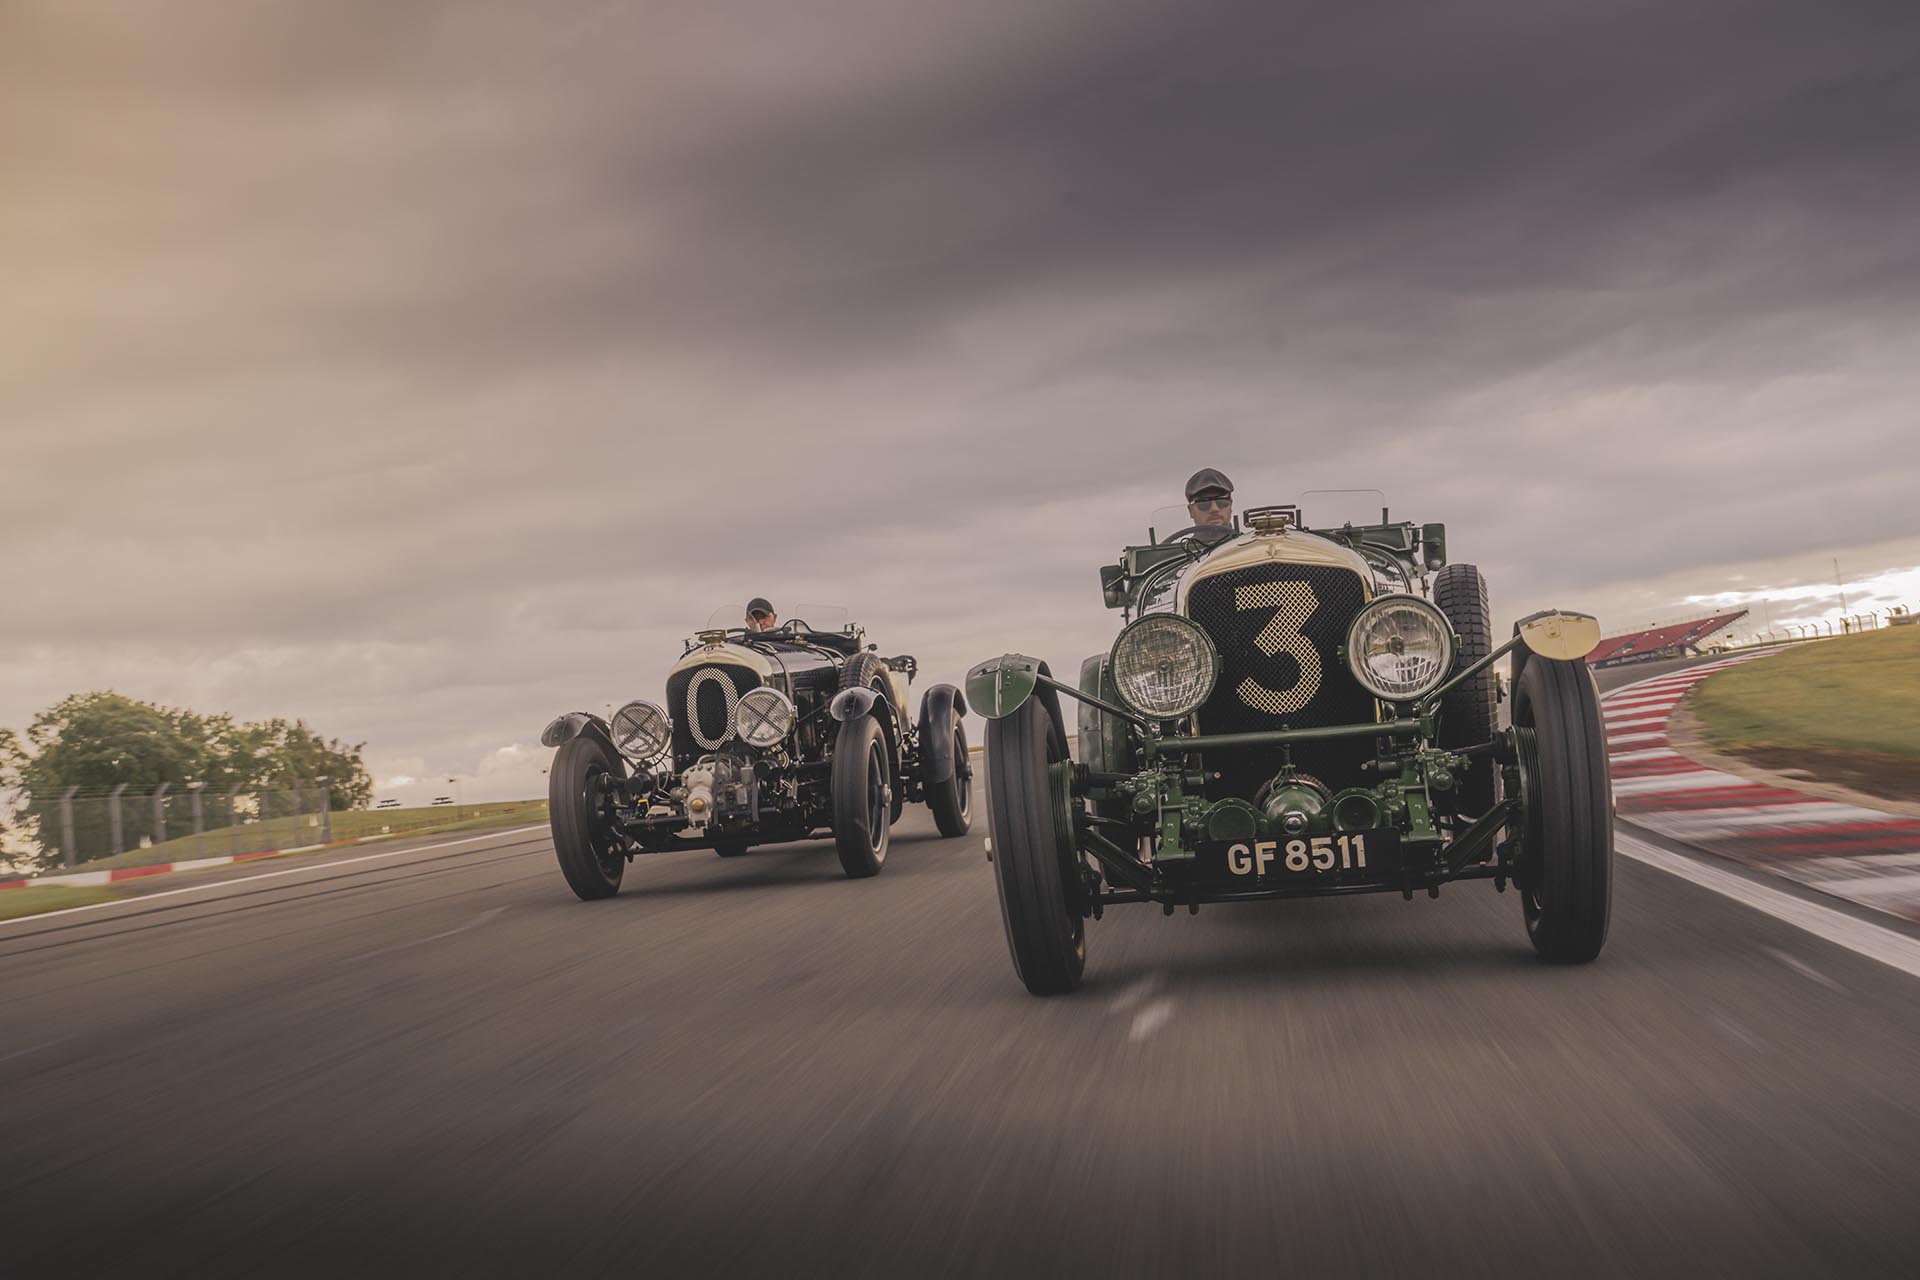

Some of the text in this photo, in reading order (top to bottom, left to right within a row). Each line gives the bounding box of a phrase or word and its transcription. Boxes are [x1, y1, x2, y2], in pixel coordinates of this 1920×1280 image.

[1234, 580, 1323, 715] 3
[1227, 834, 1367, 875] GF 8511
